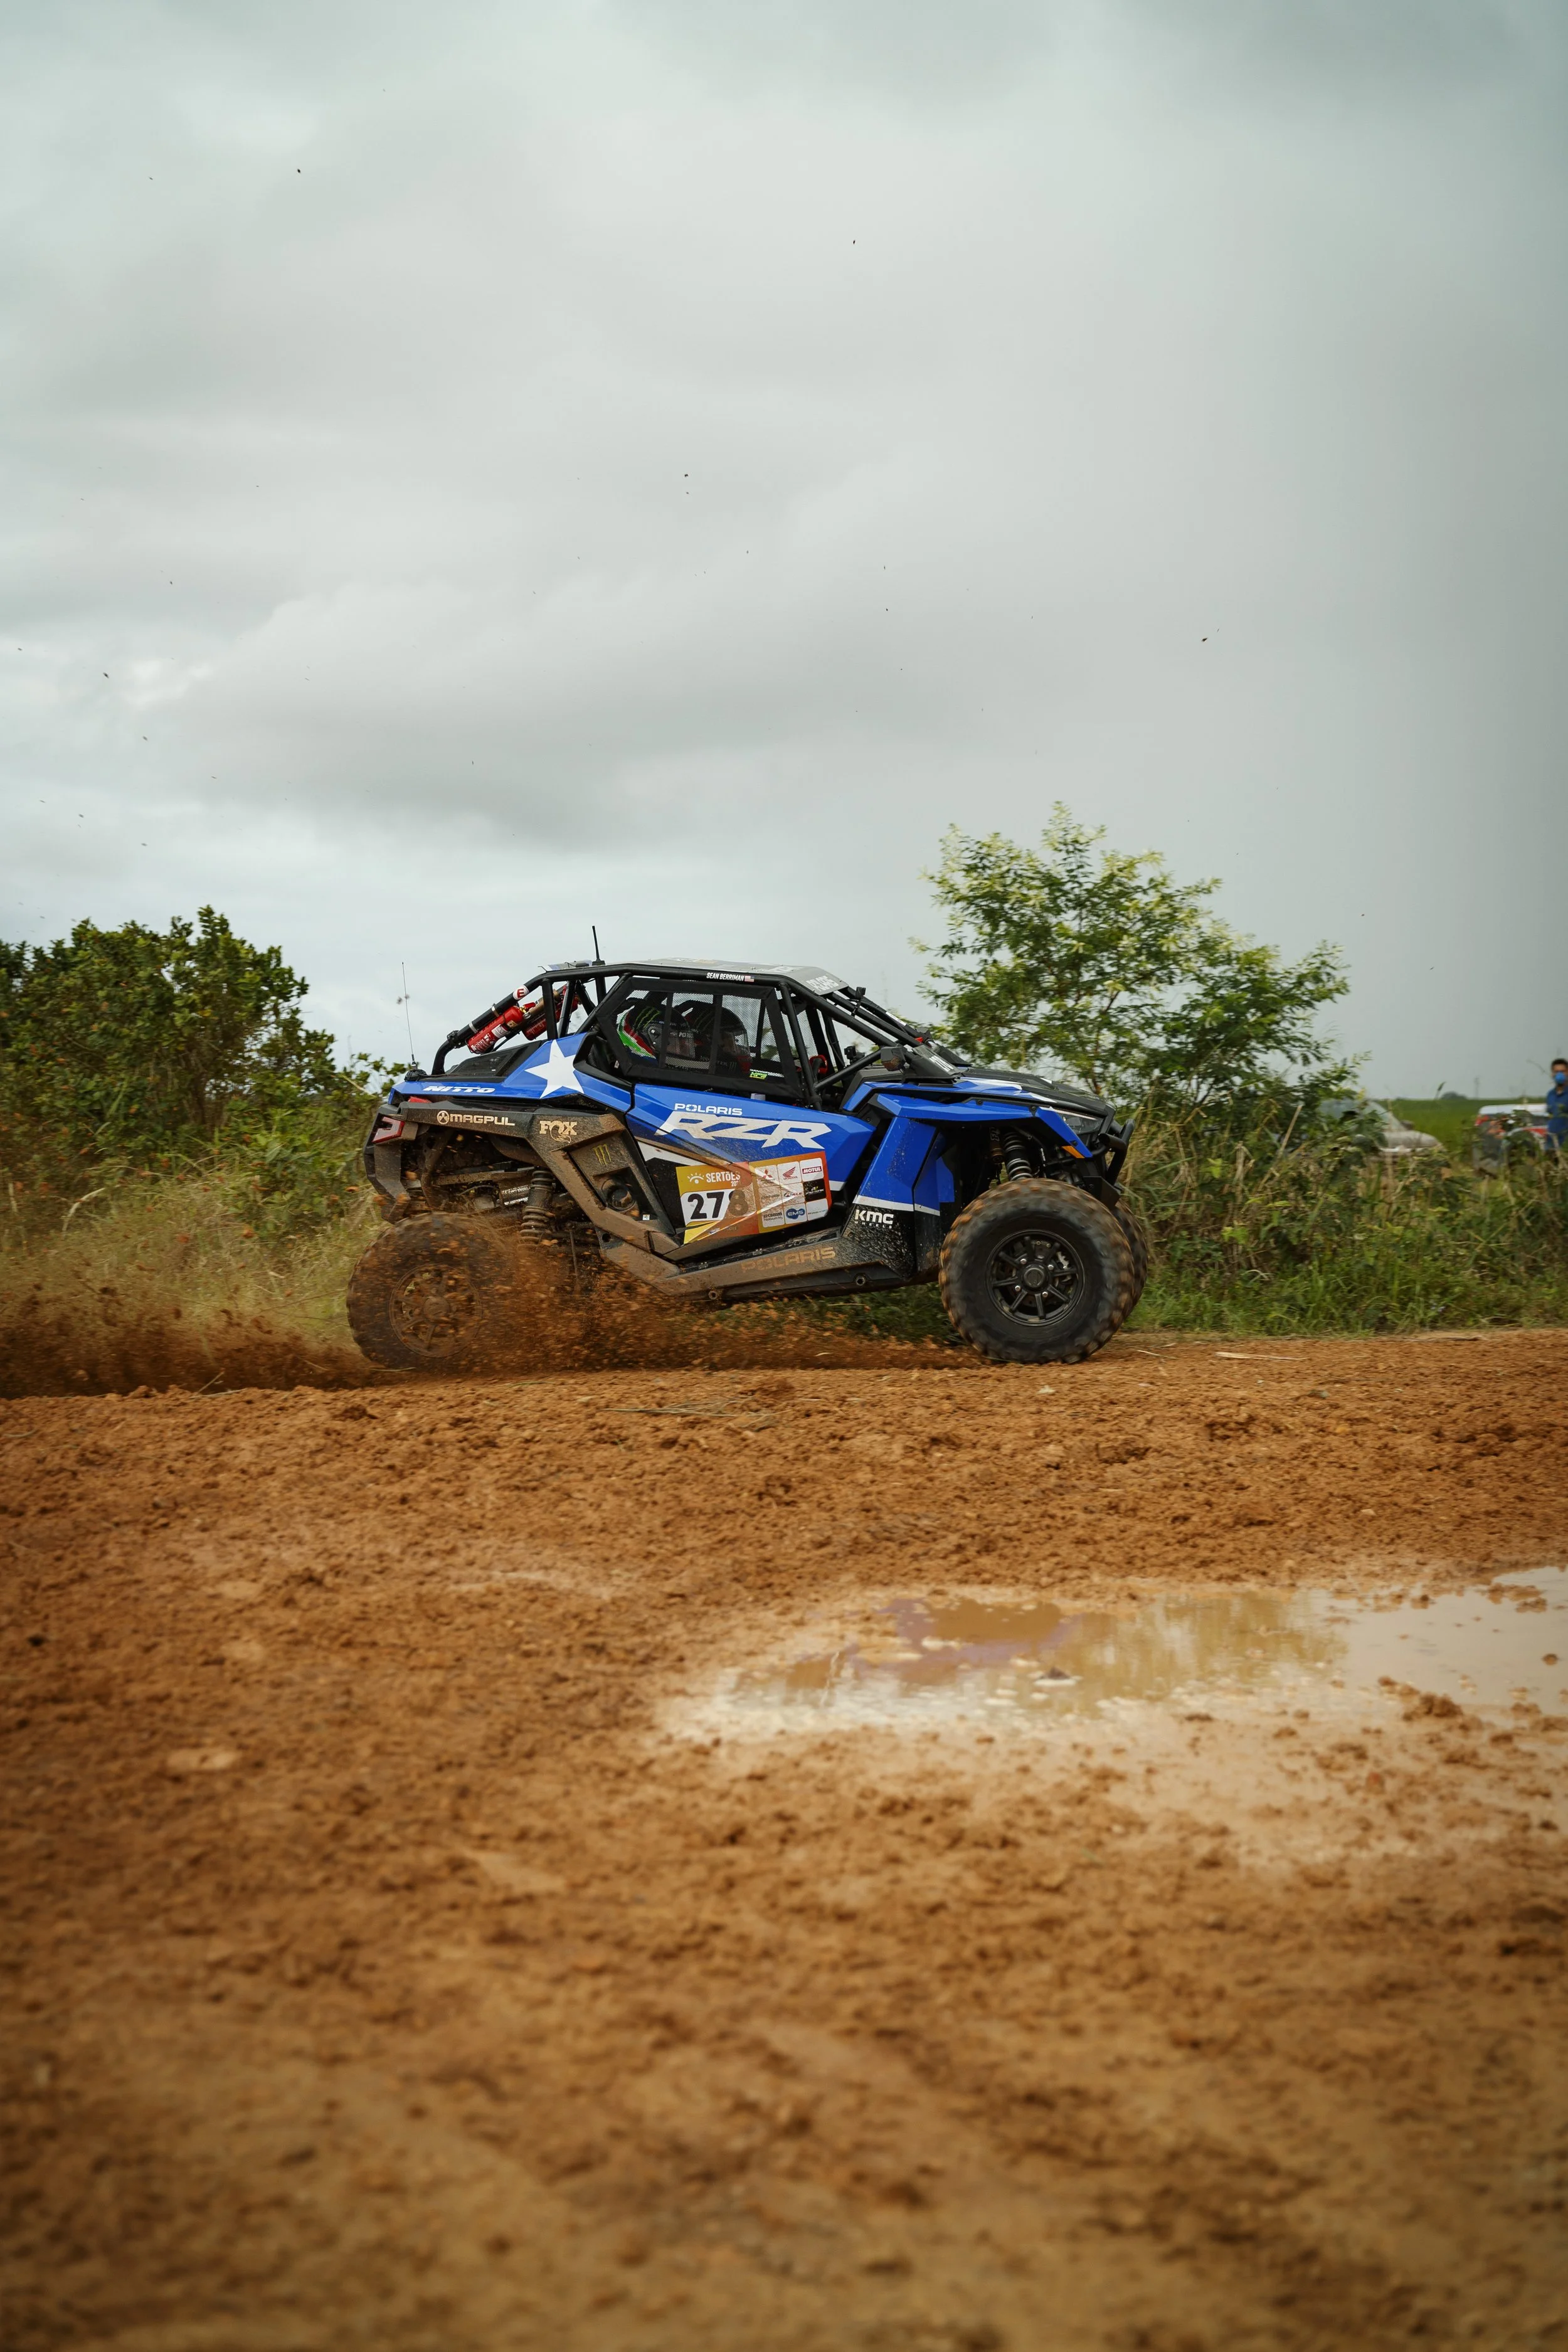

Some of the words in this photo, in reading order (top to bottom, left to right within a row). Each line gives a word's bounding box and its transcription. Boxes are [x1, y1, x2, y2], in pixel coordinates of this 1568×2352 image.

[719, 973, 744, 982] BERRIMAN
[517, 988, 526, 999] E
[674, 1103, 743, 1116] POLARIS
[450, 1114, 515, 1126] MAGPUL
[539, 1120, 577, 1136] FOX
[654, 1111, 832, 1149] RZR
[687, 1189, 748, 1220] 278
[855, 1209, 894, 1224] KMC
[854, 1221, 892, 1229] WHEELS
[741, 1246, 835, 1271] POLARIS
